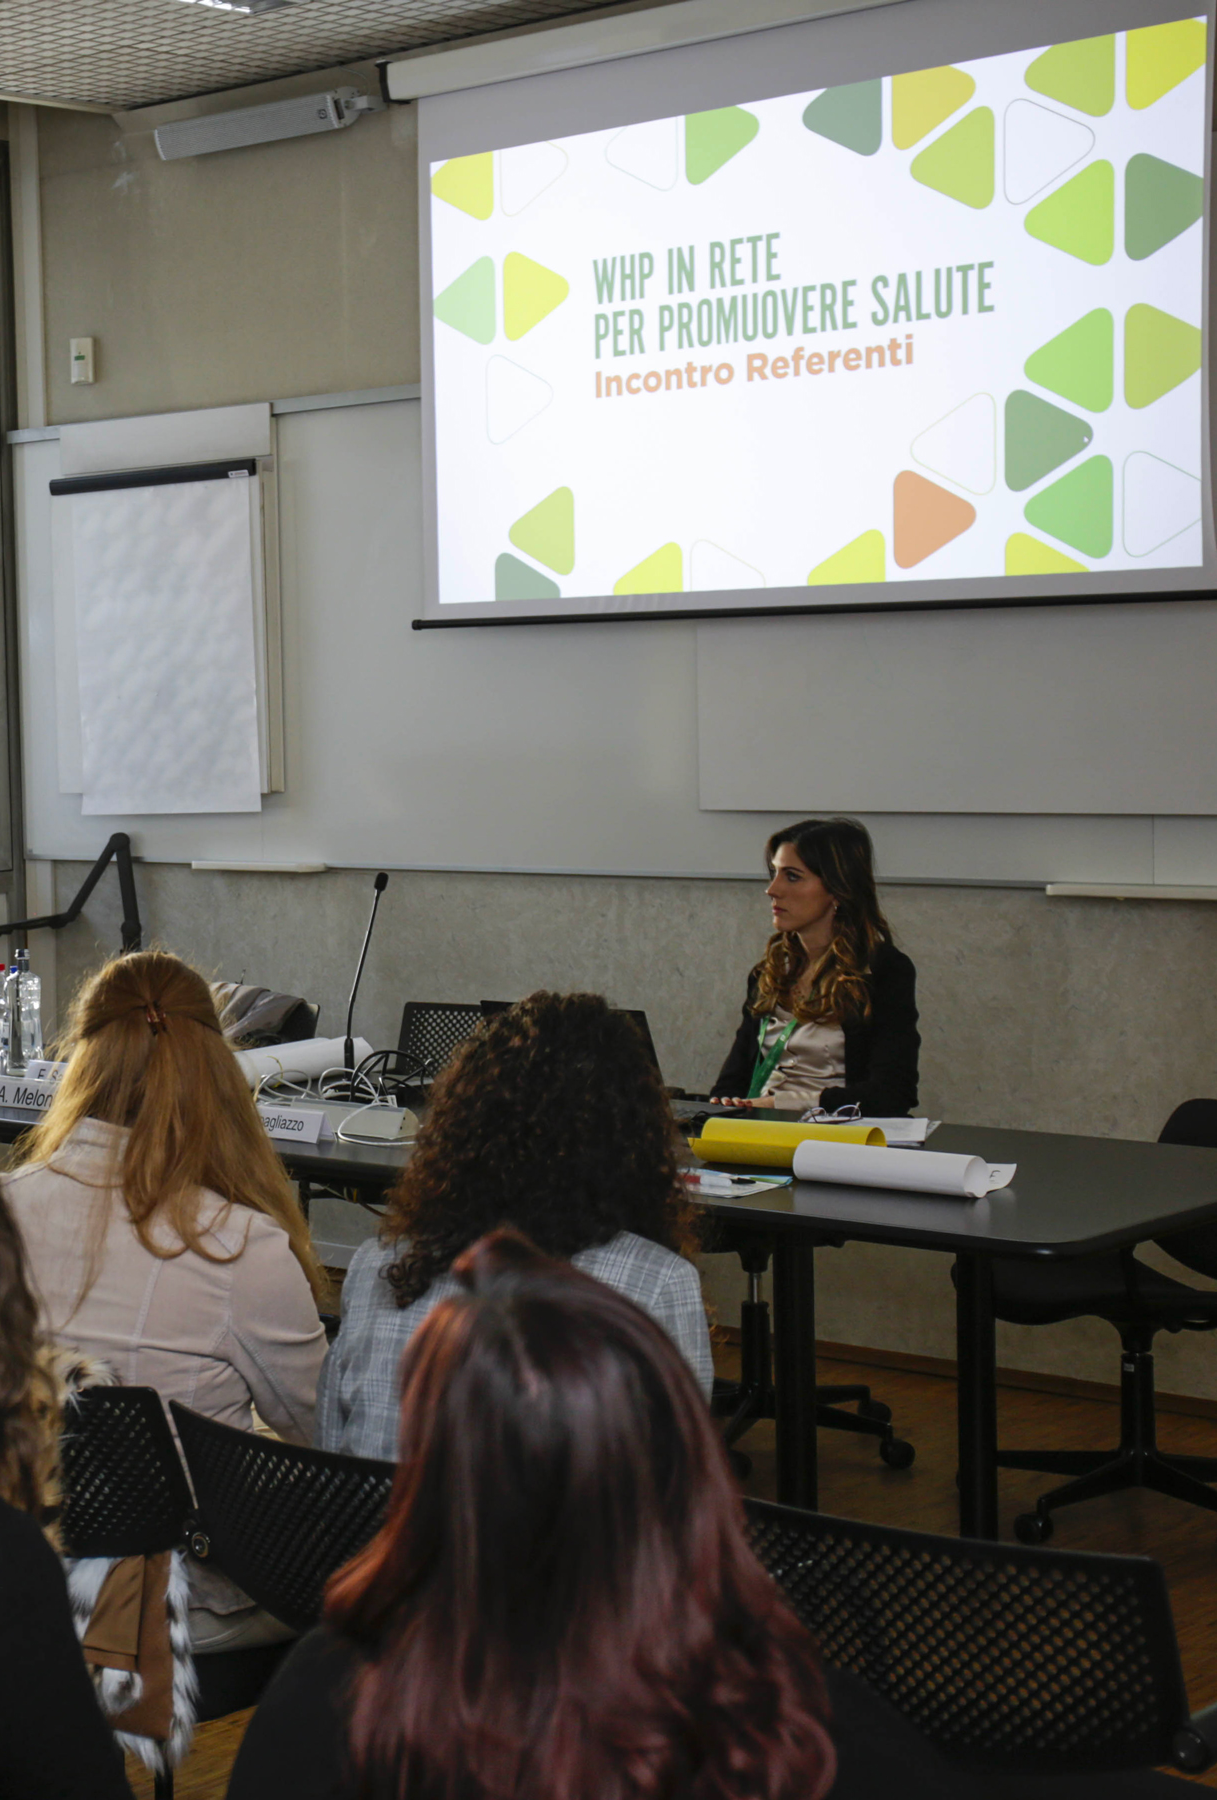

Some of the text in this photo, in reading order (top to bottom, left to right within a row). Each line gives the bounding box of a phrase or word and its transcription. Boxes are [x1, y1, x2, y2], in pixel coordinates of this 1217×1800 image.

[593, 231, 781, 305] WHP IN RETE
[594, 260, 995, 359] PER PROMUOVERE SALUTE
[595, 333, 914, 399] Incontro Referenti
